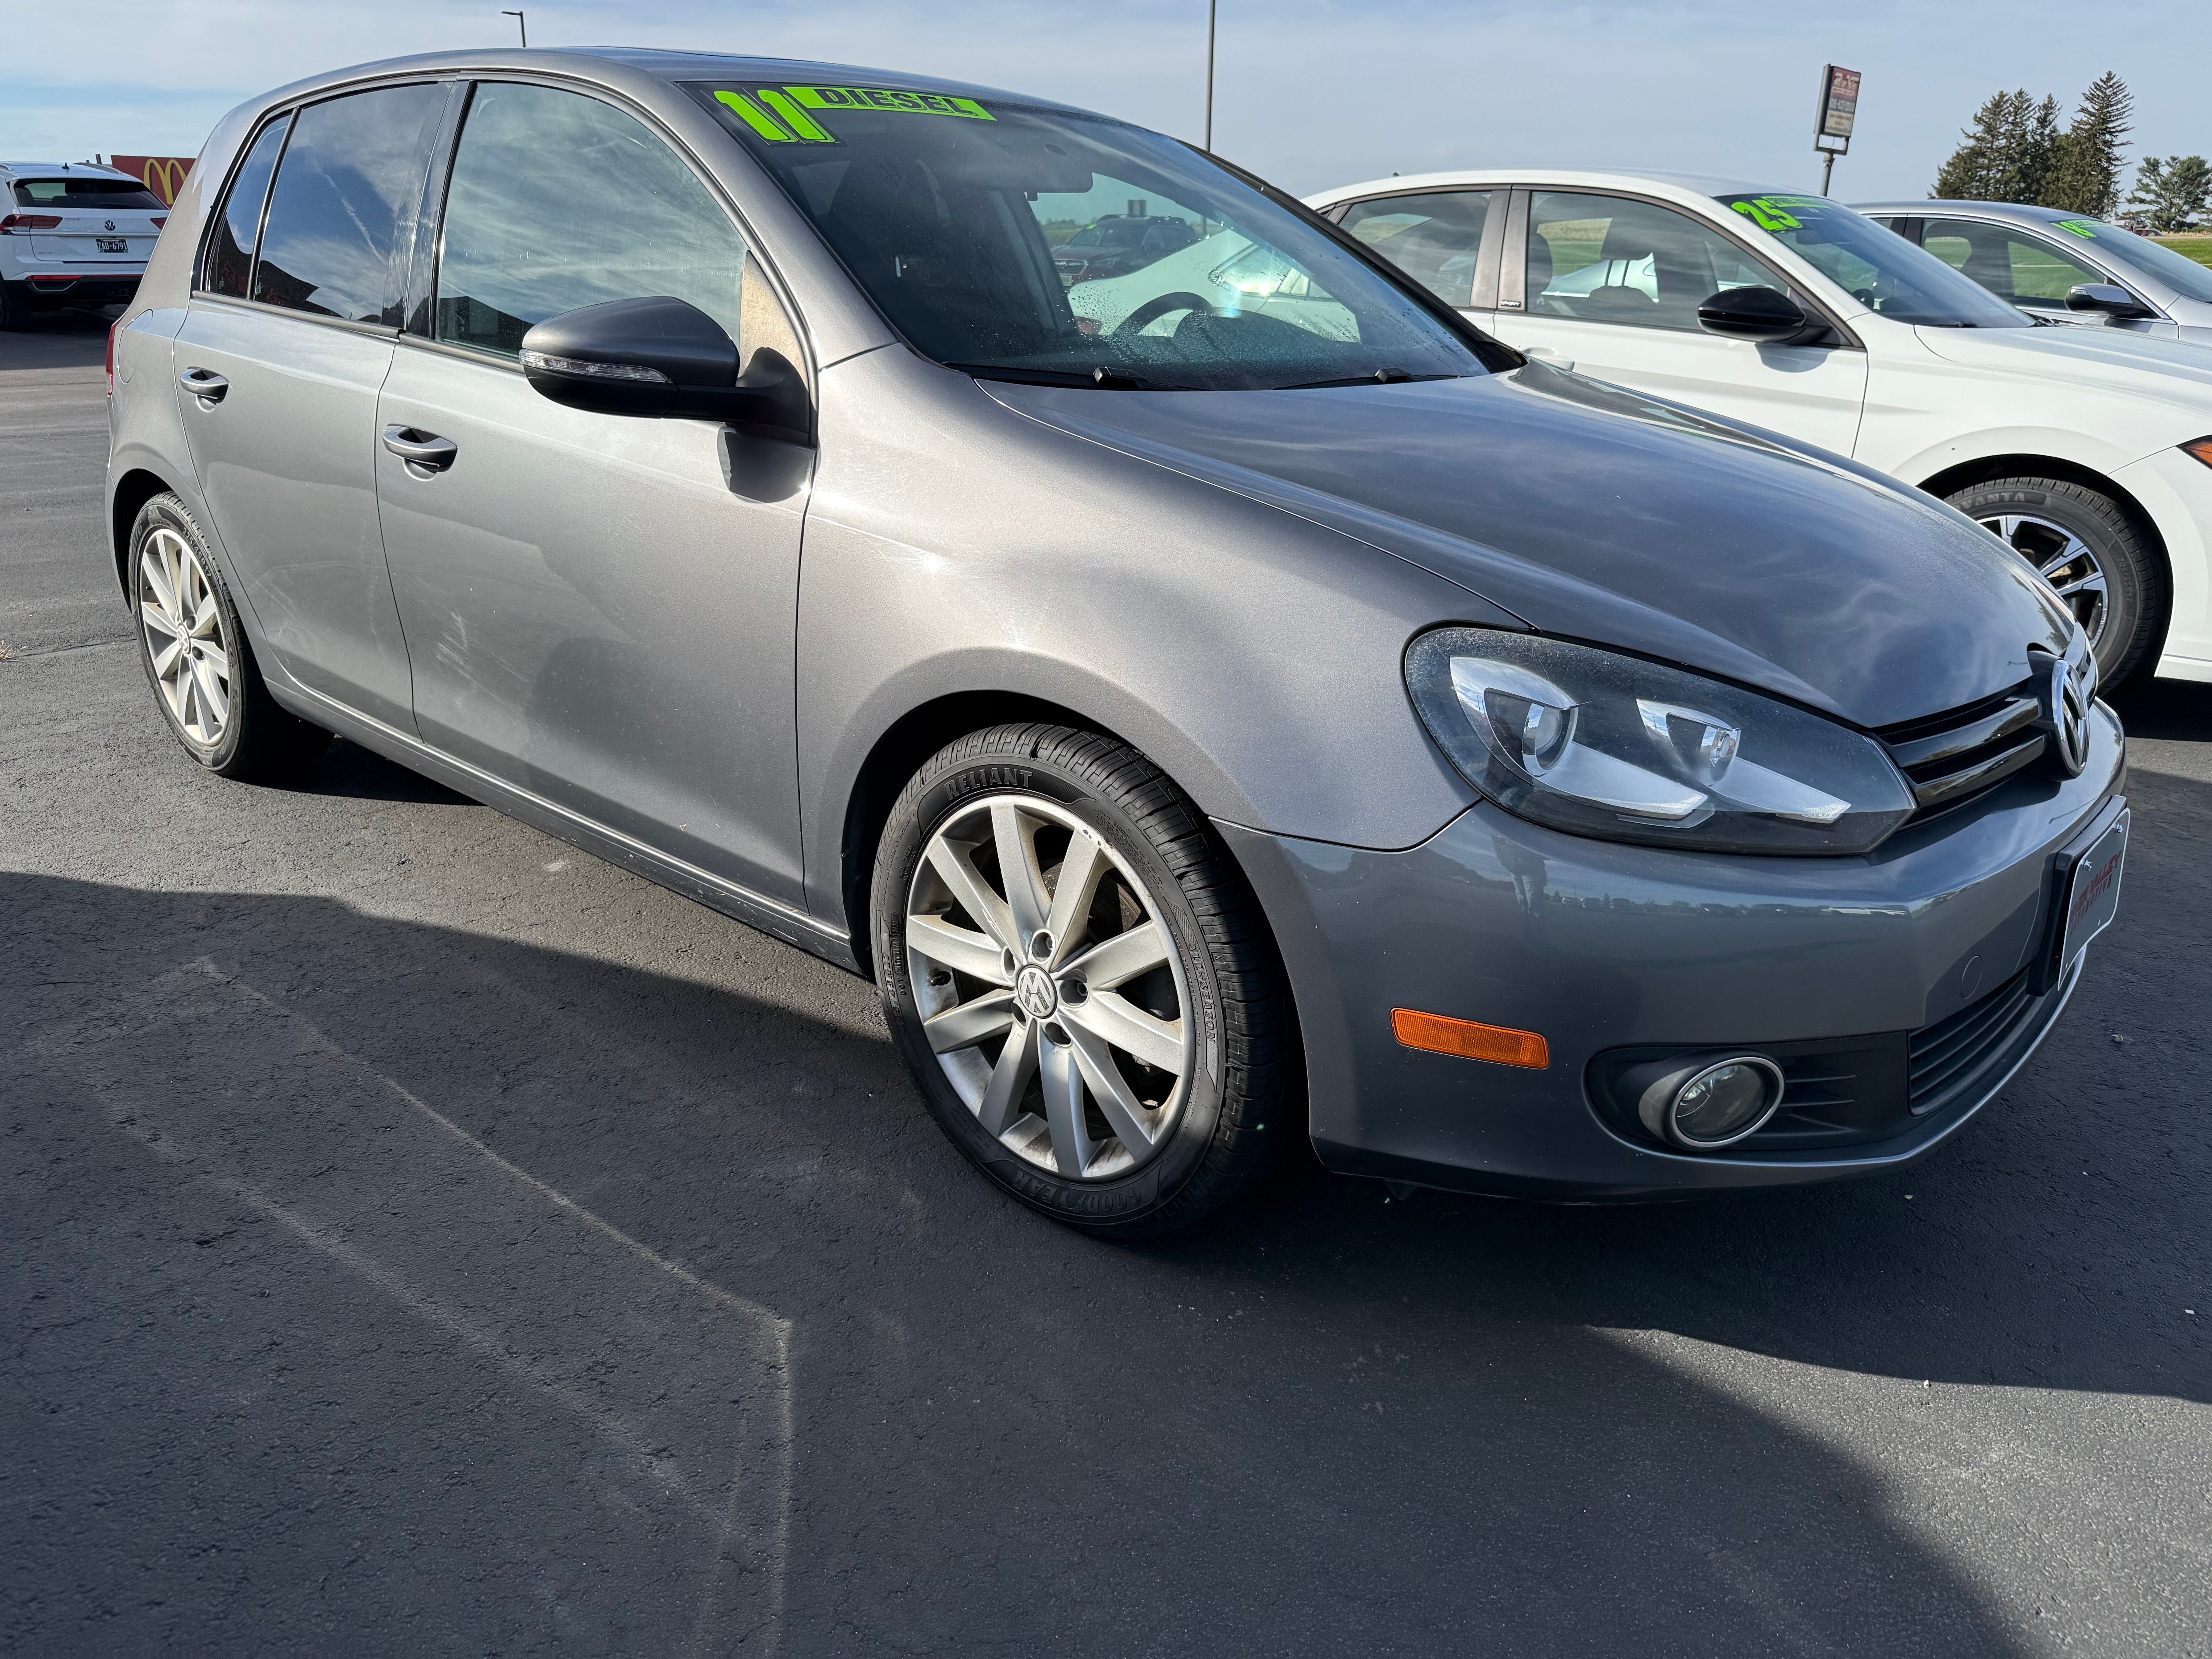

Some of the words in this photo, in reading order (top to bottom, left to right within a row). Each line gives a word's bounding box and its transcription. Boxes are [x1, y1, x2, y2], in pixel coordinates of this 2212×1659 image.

[714, 90, 835, 143] 11
[812, 88, 979, 117] DIESEL
[1731, 200, 1803, 231] 25
[1955, 492, 2025, 511] VANTA
[943, 768, 1033, 801] RELIANT
[1188, 942, 1216, 1043] ALL-SEASON
[1012, 1170, 1142, 1214] GOODYEAR
